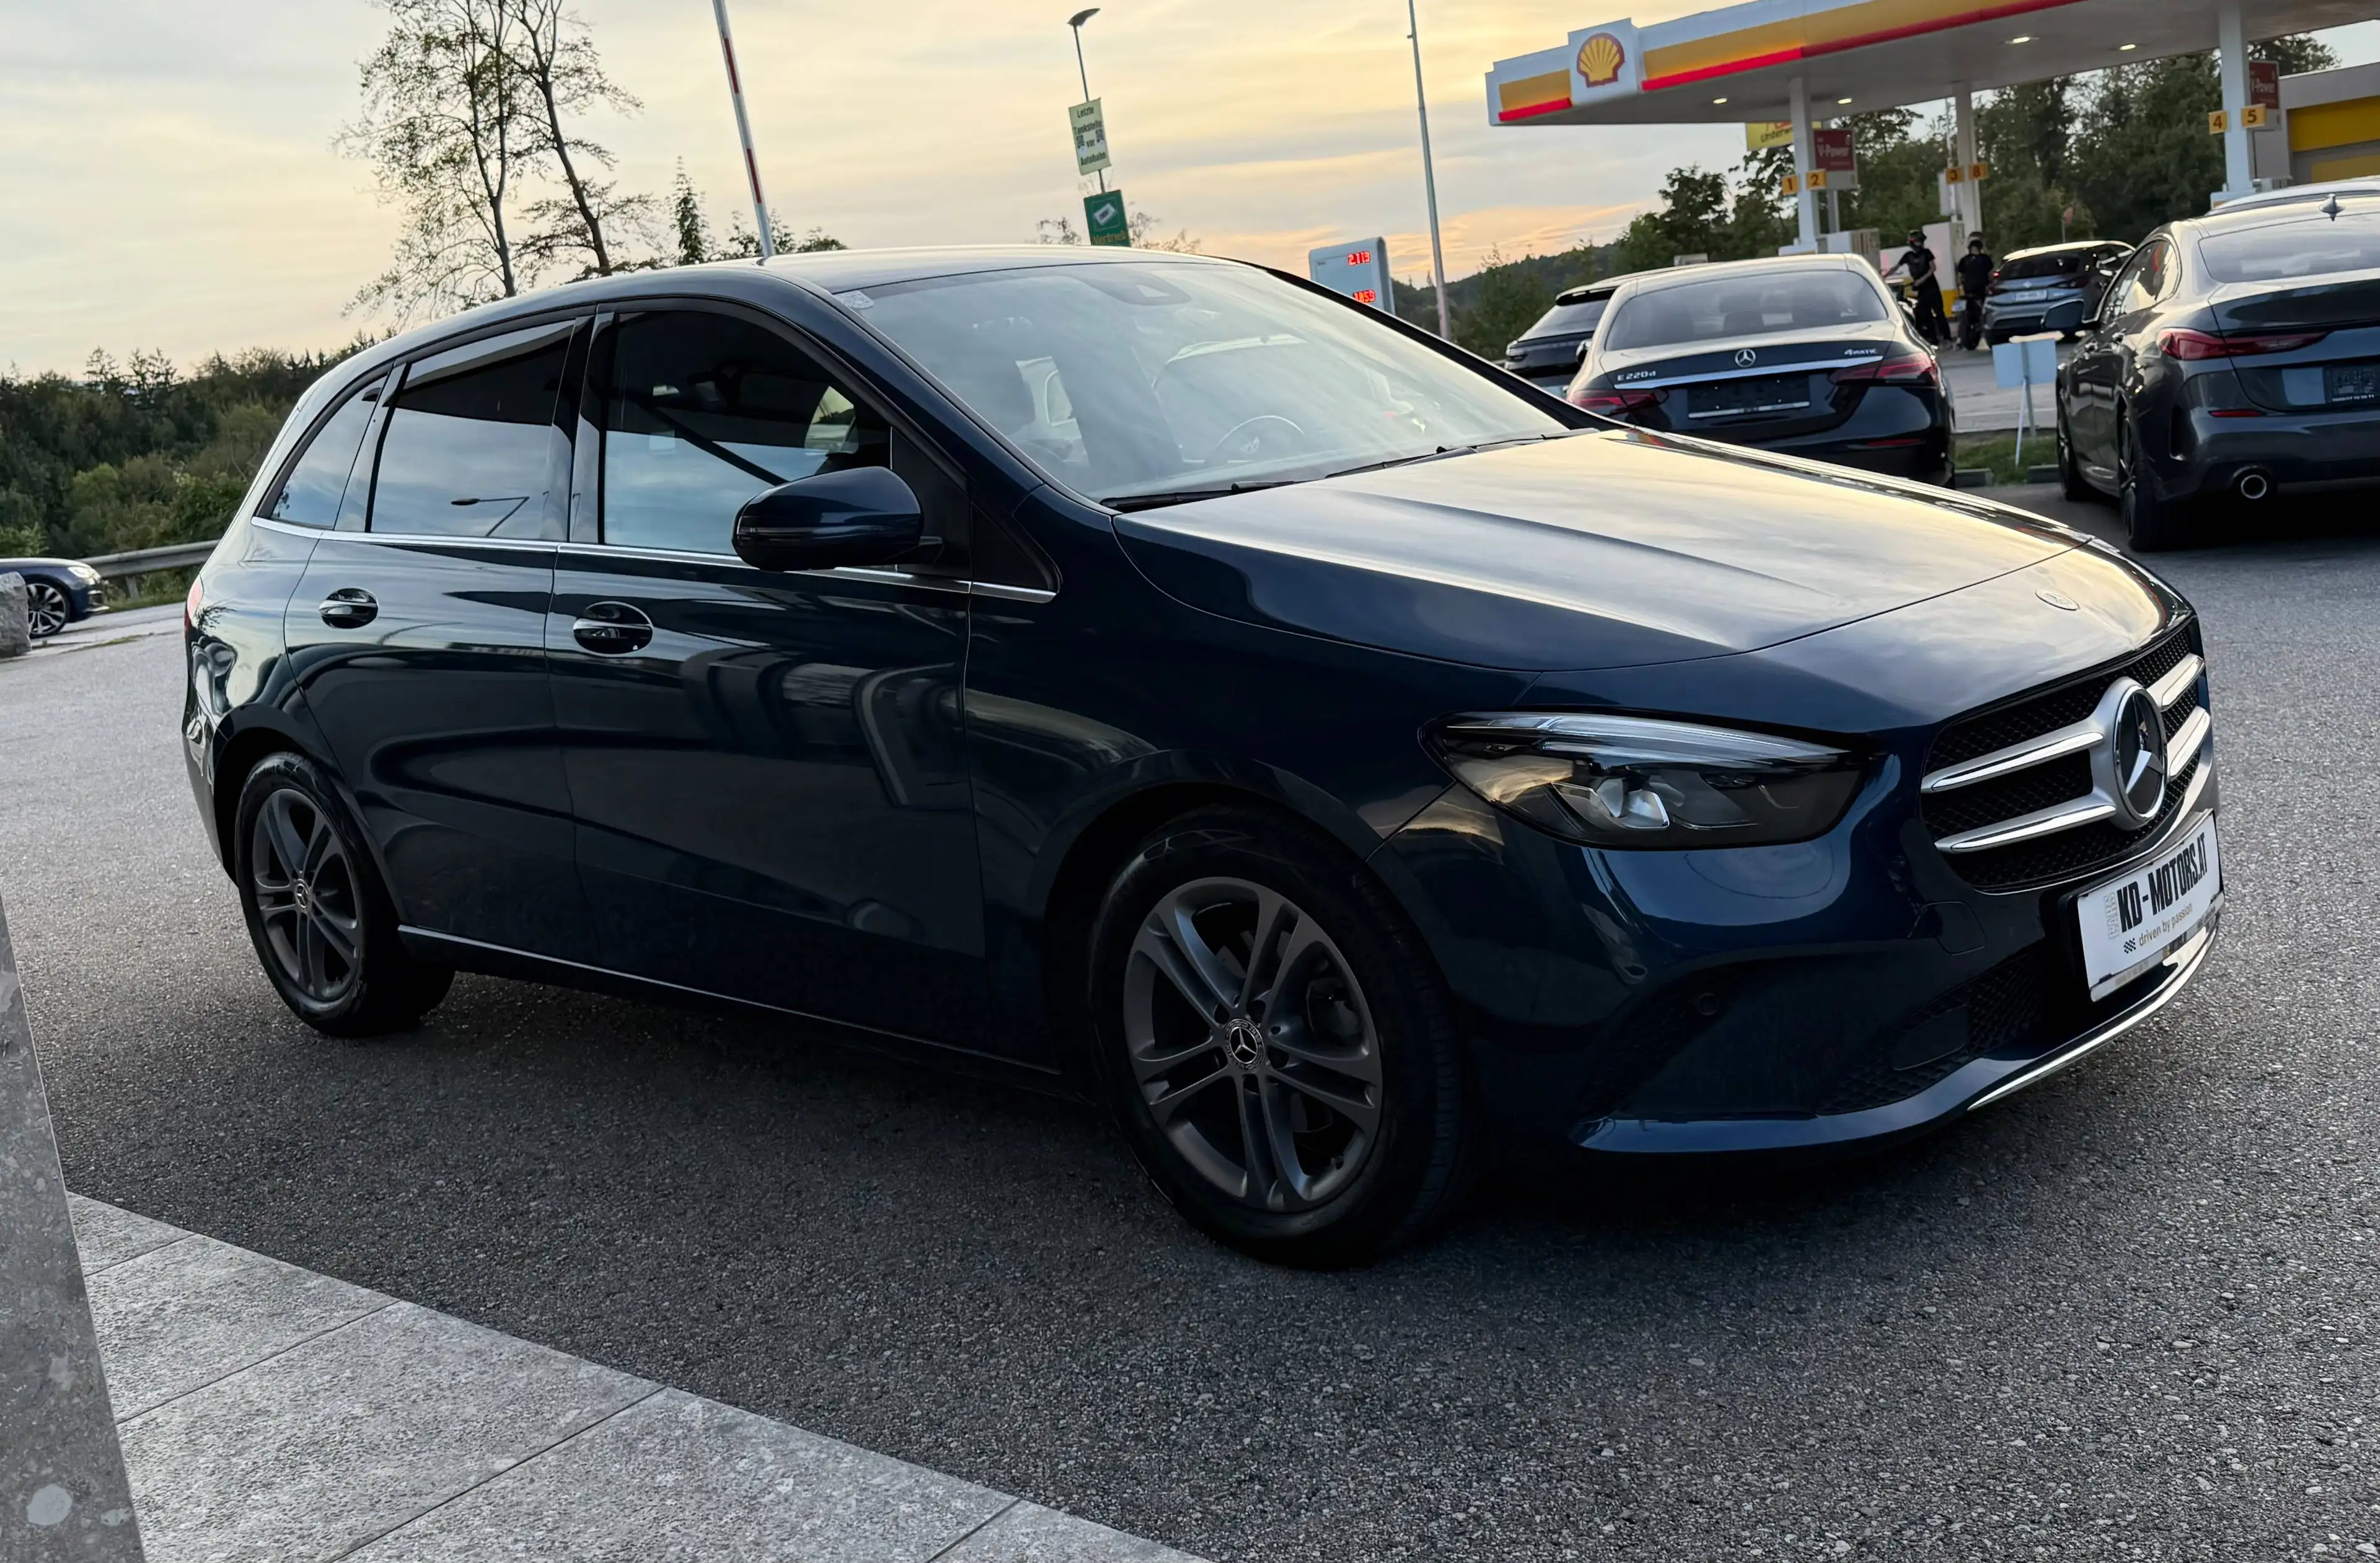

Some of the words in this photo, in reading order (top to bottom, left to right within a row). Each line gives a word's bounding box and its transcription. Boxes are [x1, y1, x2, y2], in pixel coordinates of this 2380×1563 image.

[2213, 115, 2223, 128] 4
[2247, 110, 2257, 123] 5
[1080, 152, 1106, 166] Autobahn
[1810, 174, 1820, 187] 2
[1949, 169, 1958, 181] 3
[1787, 178, 1793, 190] 1
[2139, 924, 2162, 946] driven
[2162, 918, 2171, 933] by
[2171, 902, 2193, 930] passion
